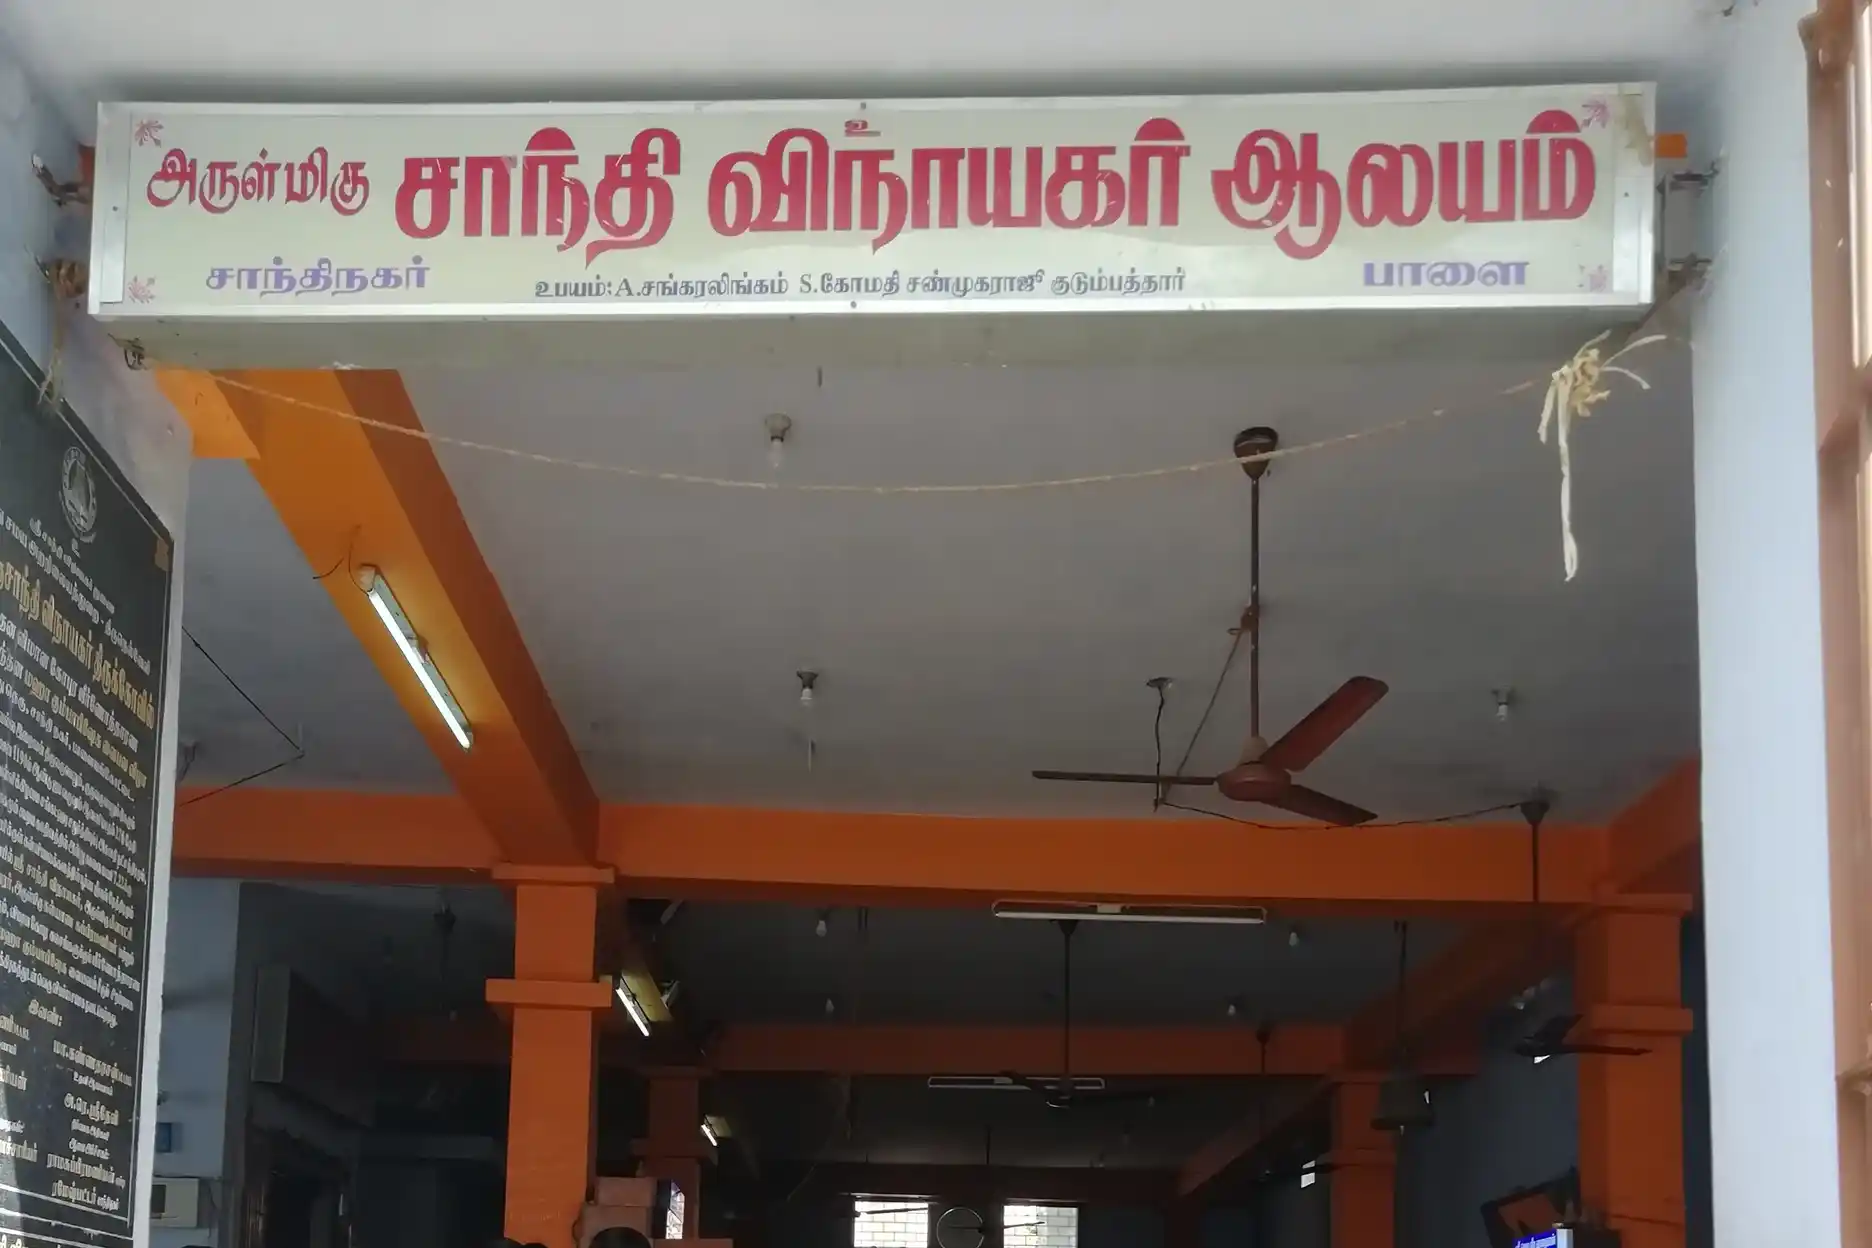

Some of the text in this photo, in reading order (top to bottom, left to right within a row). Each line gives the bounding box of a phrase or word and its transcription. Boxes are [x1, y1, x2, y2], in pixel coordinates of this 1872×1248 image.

[146, 109, 1596, 269] அருள்மிகு சாந்தி விநாயகர் ஆலயம்
[205, 254, 430, 298] சாந்திநகர்
[799, 270, 901, 297] S.கோமதி
[1050, 266, 1187, 297] குடும்பத்தார்
[1362, 258, 1530, 288] பாளை
[41, 584, 94, 677] விநாயகர்
